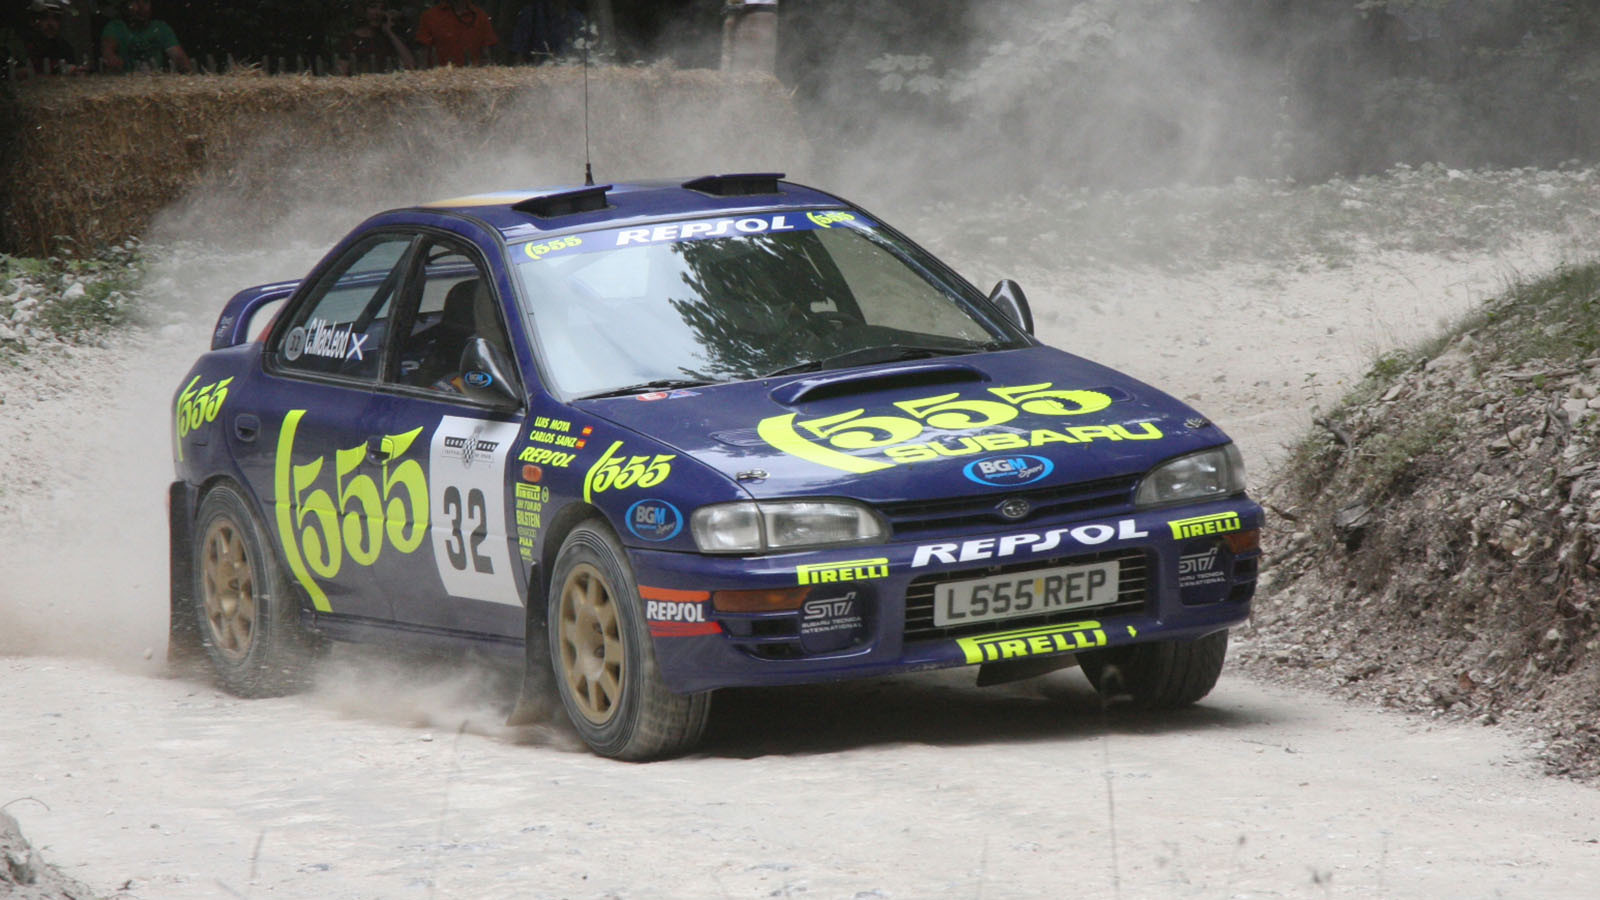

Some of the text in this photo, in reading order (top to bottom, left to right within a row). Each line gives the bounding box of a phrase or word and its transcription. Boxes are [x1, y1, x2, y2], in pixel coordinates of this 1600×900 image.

[616, 216, 794, 246] REPSOL
[534, 416, 571, 432] LUIS MOYA
[797, 382, 1112, 449] 555
[529, 429, 577, 448] CARLOS SAINZ
[883, 422, 1164, 464] SUBARU
[518, 446, 577, 468] REPSOL
[978, 458, 1028, 474] BGM
[293, 426, 429, 578] 555
[636, 505, 666, 524] BGM
[443, 485, 495, 575] 32
[1167, 511, 1241, 540] PIRELLI
[911, 519, 1149, 568] REPSOL
[797, 557, 889, 585] PIRELLI
[947, 569, 1107, 620] L555 REP
[646, 600, 705, 623] REPSOL
[956, 620, 1107, 664] PIRELLI
